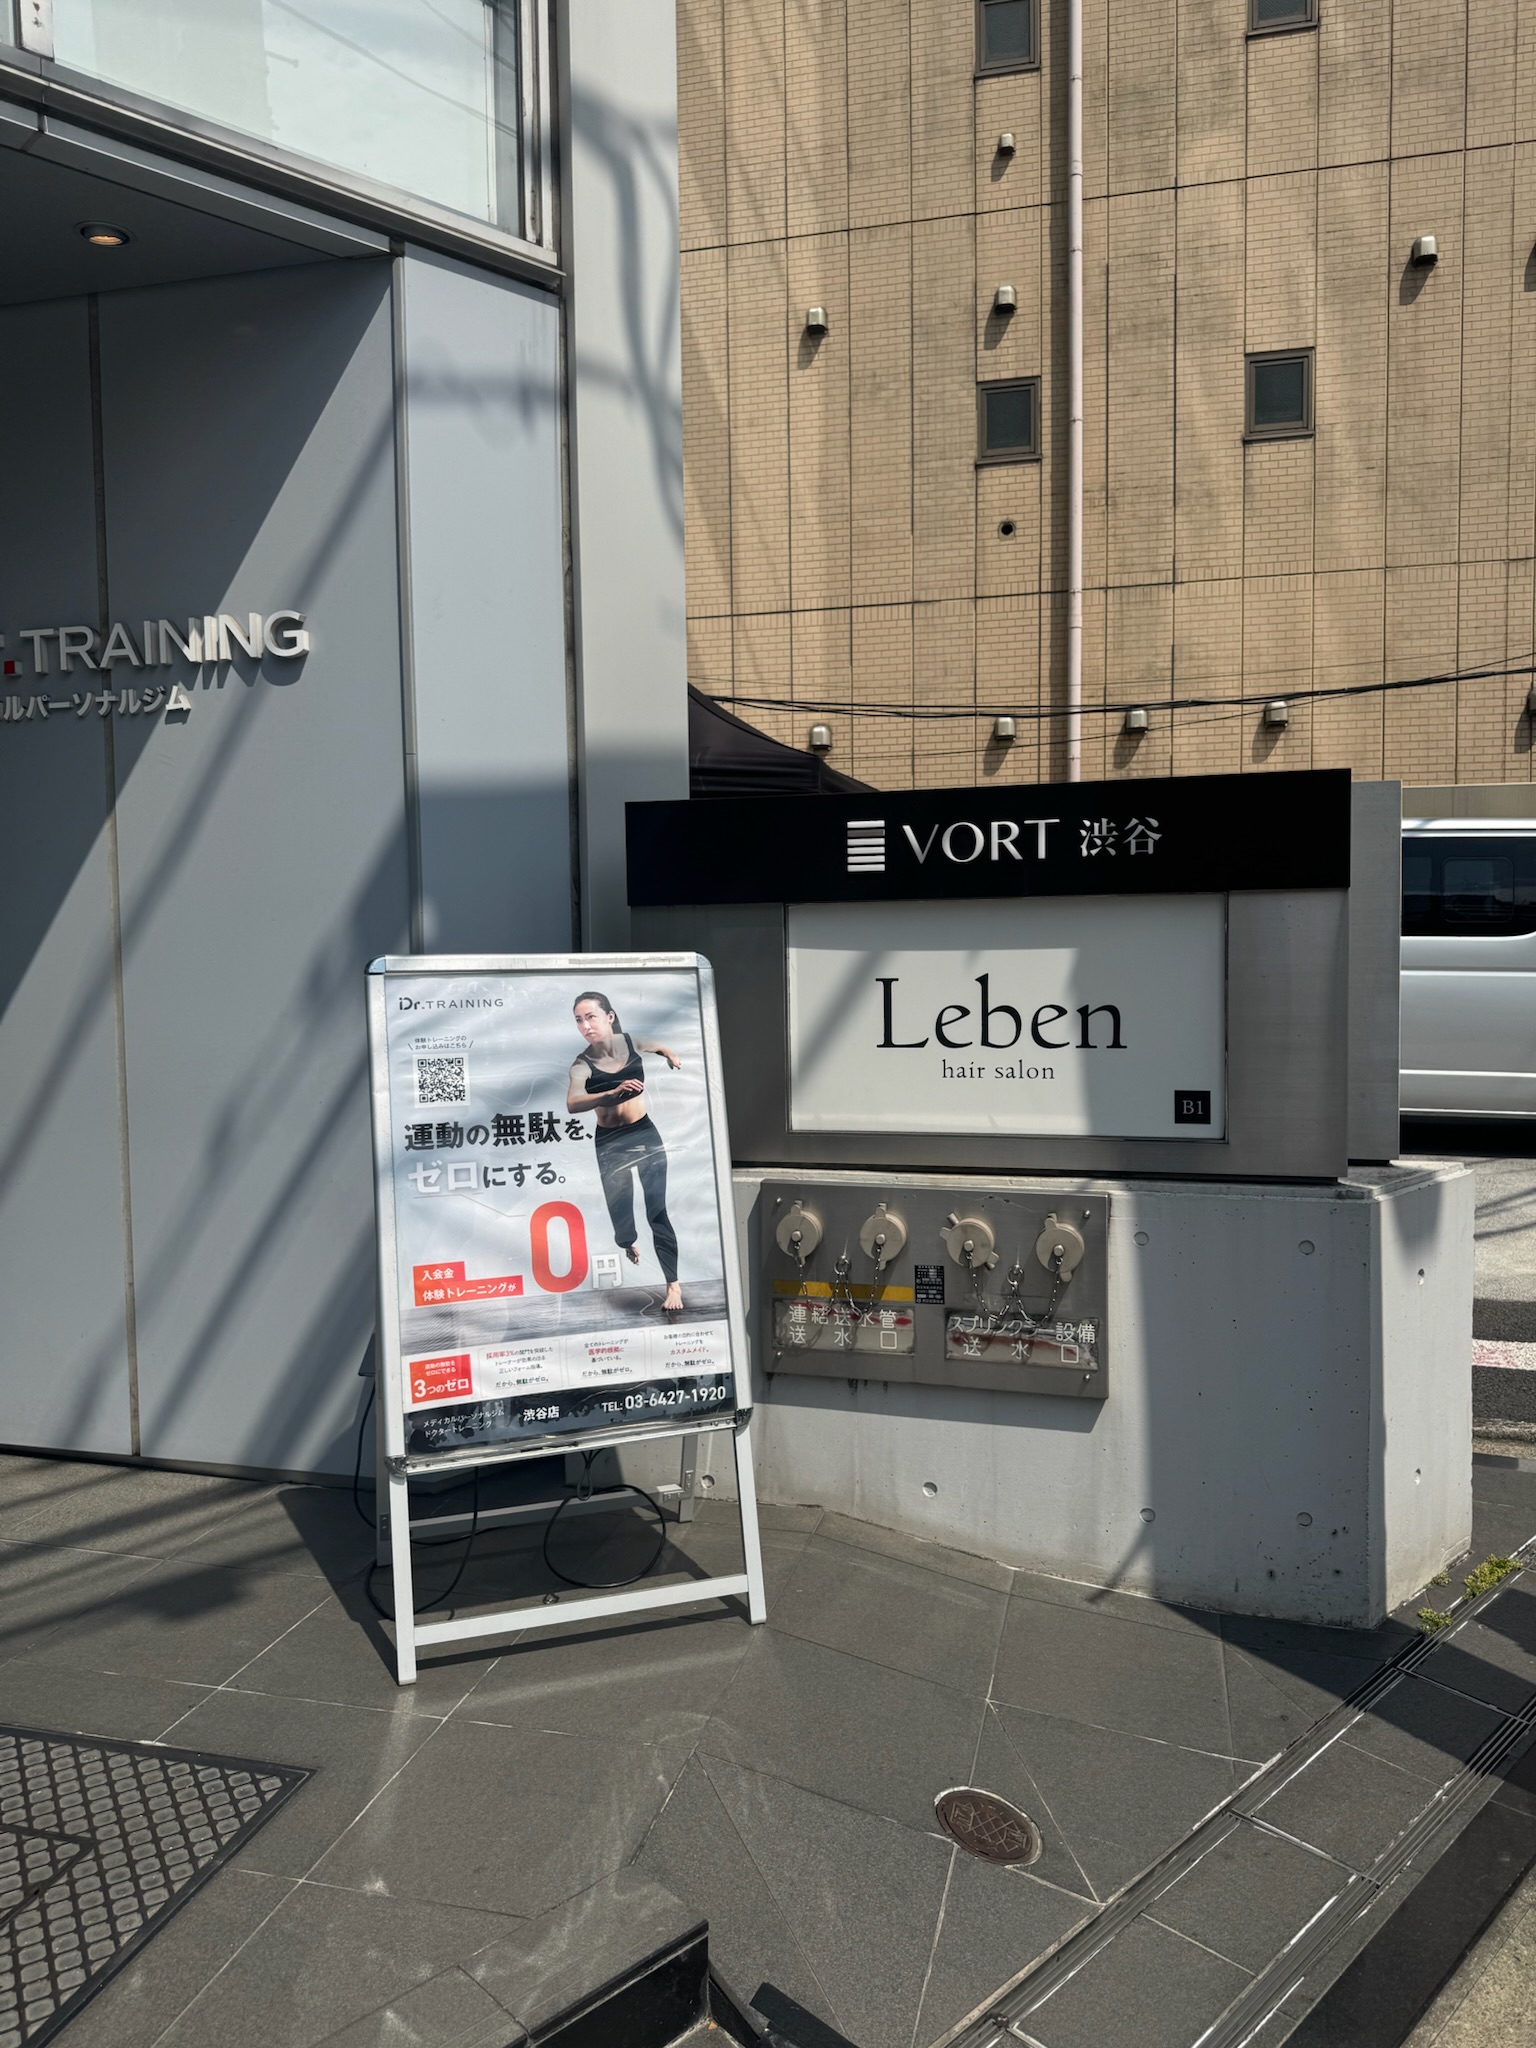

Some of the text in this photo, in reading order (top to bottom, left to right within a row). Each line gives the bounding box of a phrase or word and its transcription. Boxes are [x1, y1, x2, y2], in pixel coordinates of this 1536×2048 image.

[902, 817, 1162, 864] VORT 渋谷
[875, 972, 1128, 1049] Leben
[942, 1059, 1055, 1080] hair salon
[1182, 1100, 1204, 1115] B1
[404, 1111, 593, 1151] 運動の無駄を、
[408, 1160, 566, 1194] ゼロにする。
[422, 1268, 454, 1281] 入会金
[423, 1282, 516, 1301] 体験トレーニングが
[789, 1304, 897, 1329] 連結送水管
[414, 1378, 469, 1398] 3つのゼロ
[625, 1386, 726, 1410] 03-6427-1920
[523, 1405, 560, 1421] 渋谷店
[425, 1420, 492, 1438] ドクタートレーニング
